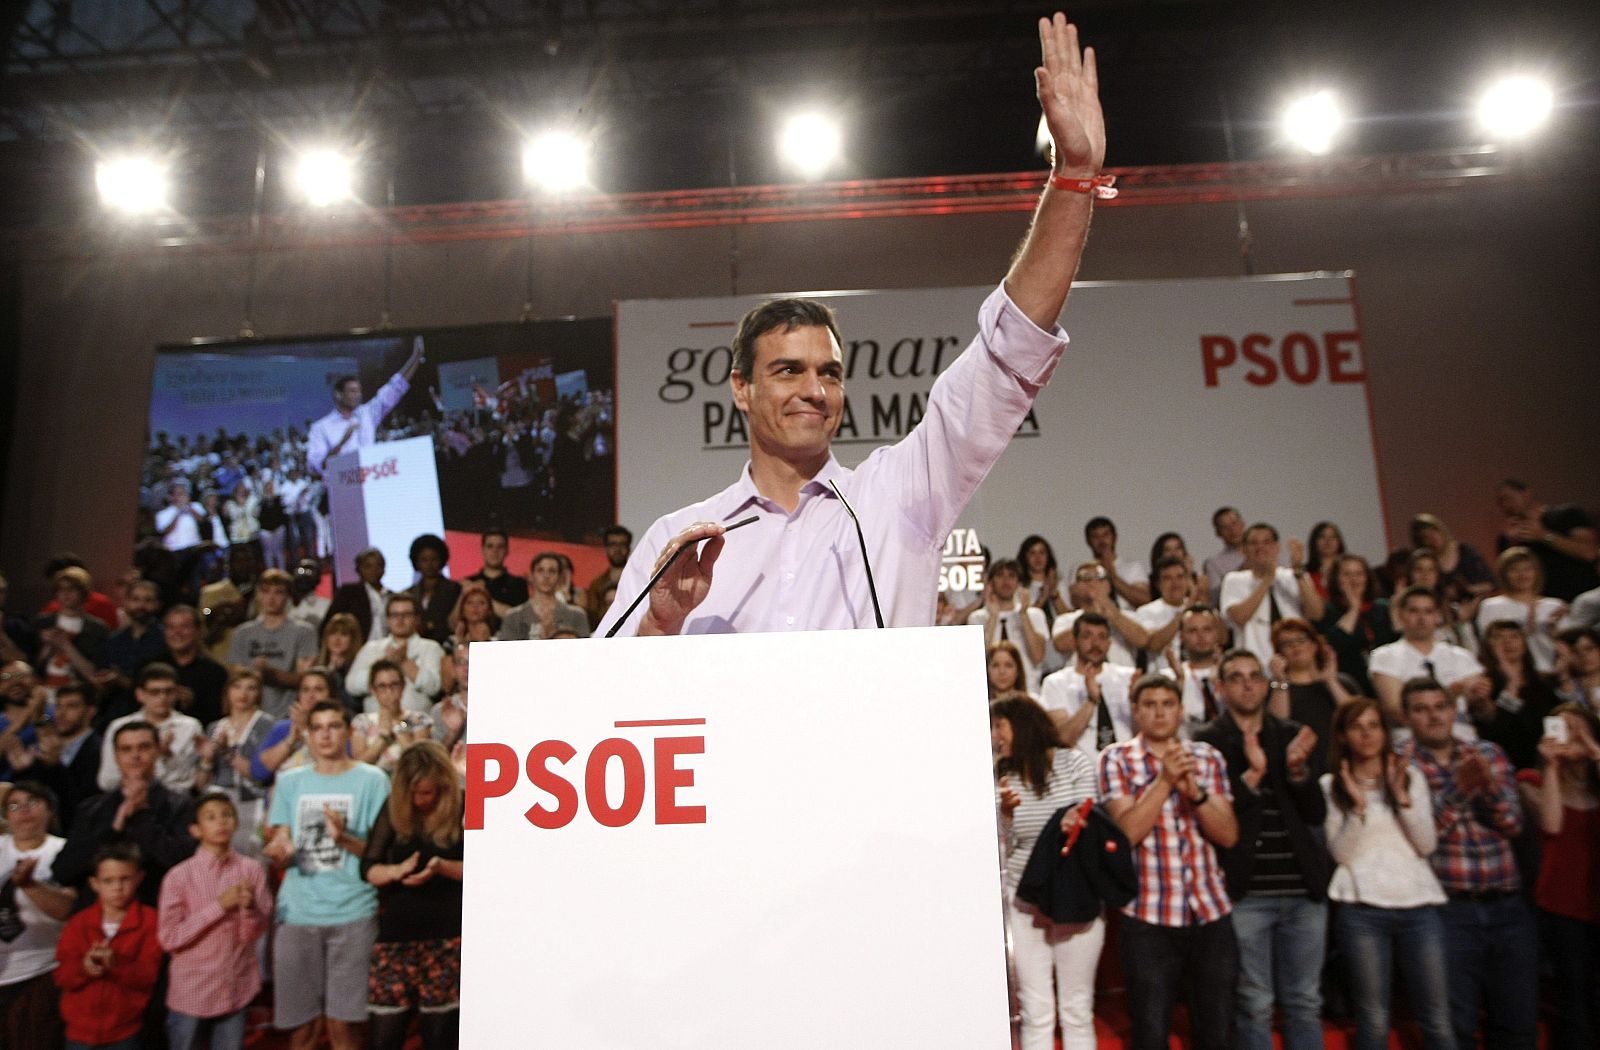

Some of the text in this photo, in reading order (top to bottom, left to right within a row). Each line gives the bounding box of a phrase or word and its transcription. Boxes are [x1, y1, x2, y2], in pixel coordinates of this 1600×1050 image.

[658, 335, 960, 404] gonar
[1200, 331, 1368, 388] PSOE
[938, 564, 985, 592] SOE
[463, 735, 707, 831] PSOE
